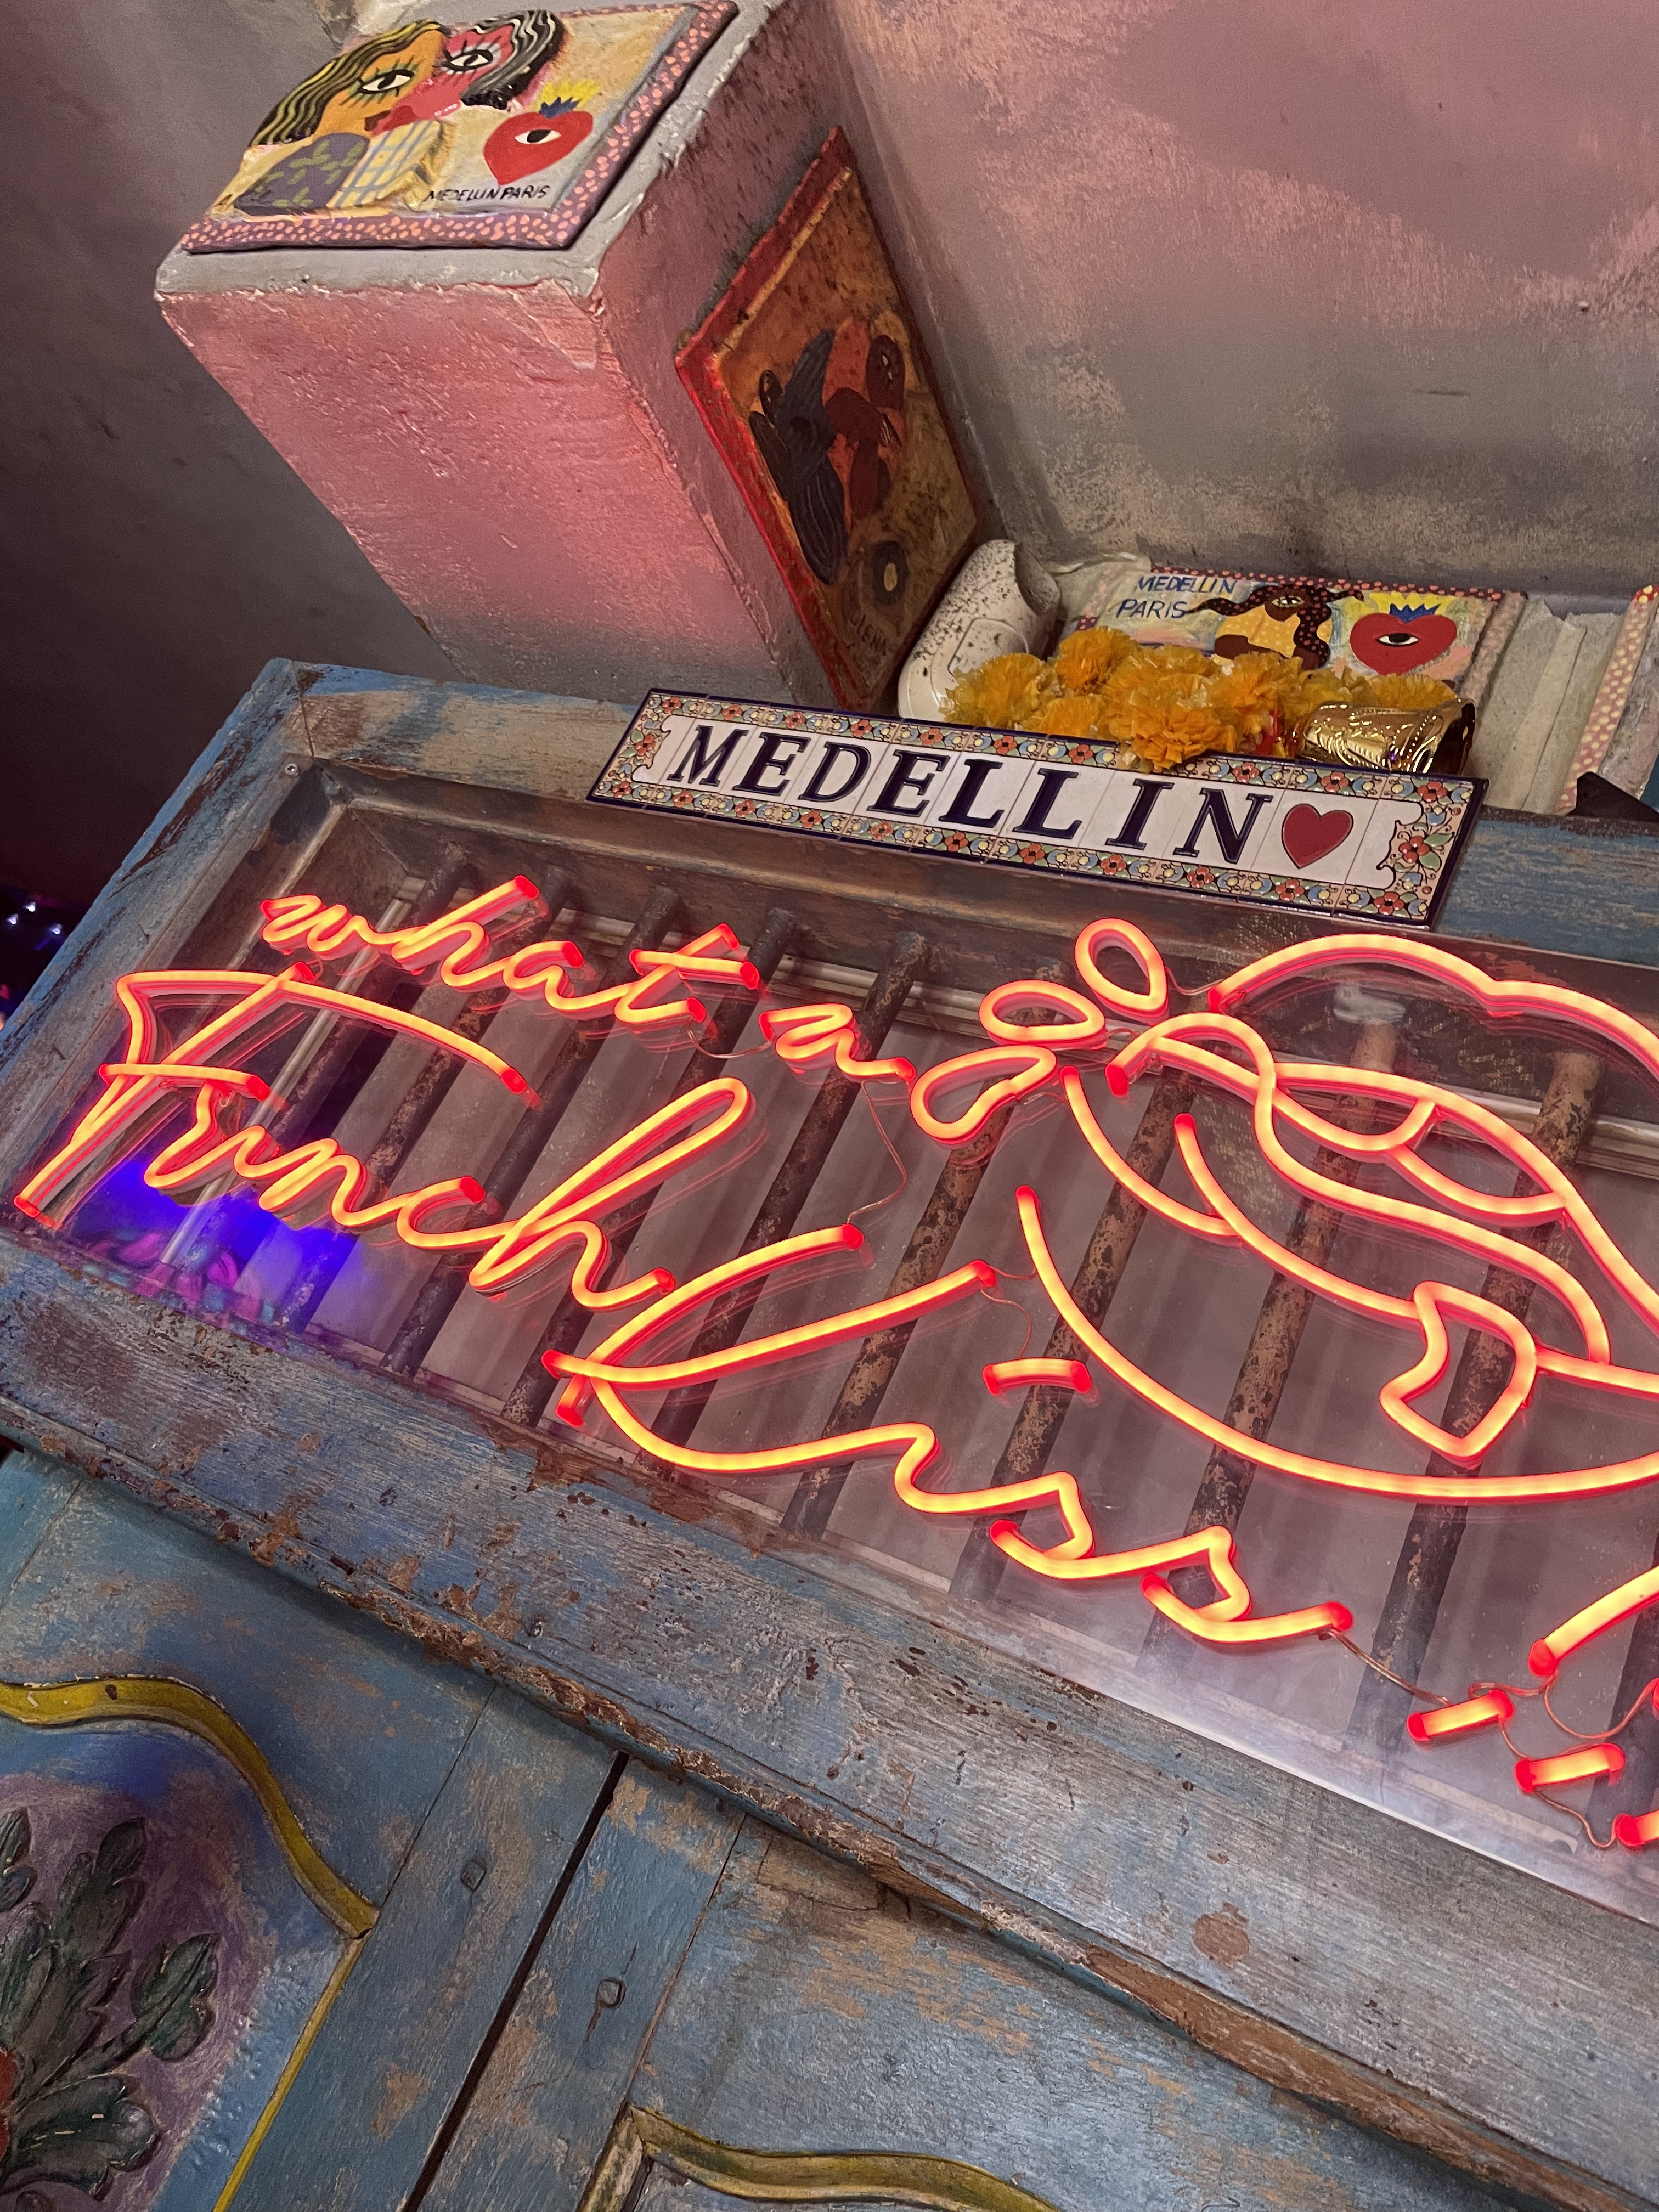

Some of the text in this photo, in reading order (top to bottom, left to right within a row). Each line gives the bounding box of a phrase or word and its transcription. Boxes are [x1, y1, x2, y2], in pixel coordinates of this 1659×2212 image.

[500, 185, 550, 200] PARIS
[1115, 598, 1188, 620] PARIS
[1138, 575, 1238, 594] MEDELLIN
[666, 724, 1273, 864] MEDELLIN
[259, 874, 916, 1083] what a
[542, 1221, 1354, 1645] Kiss
